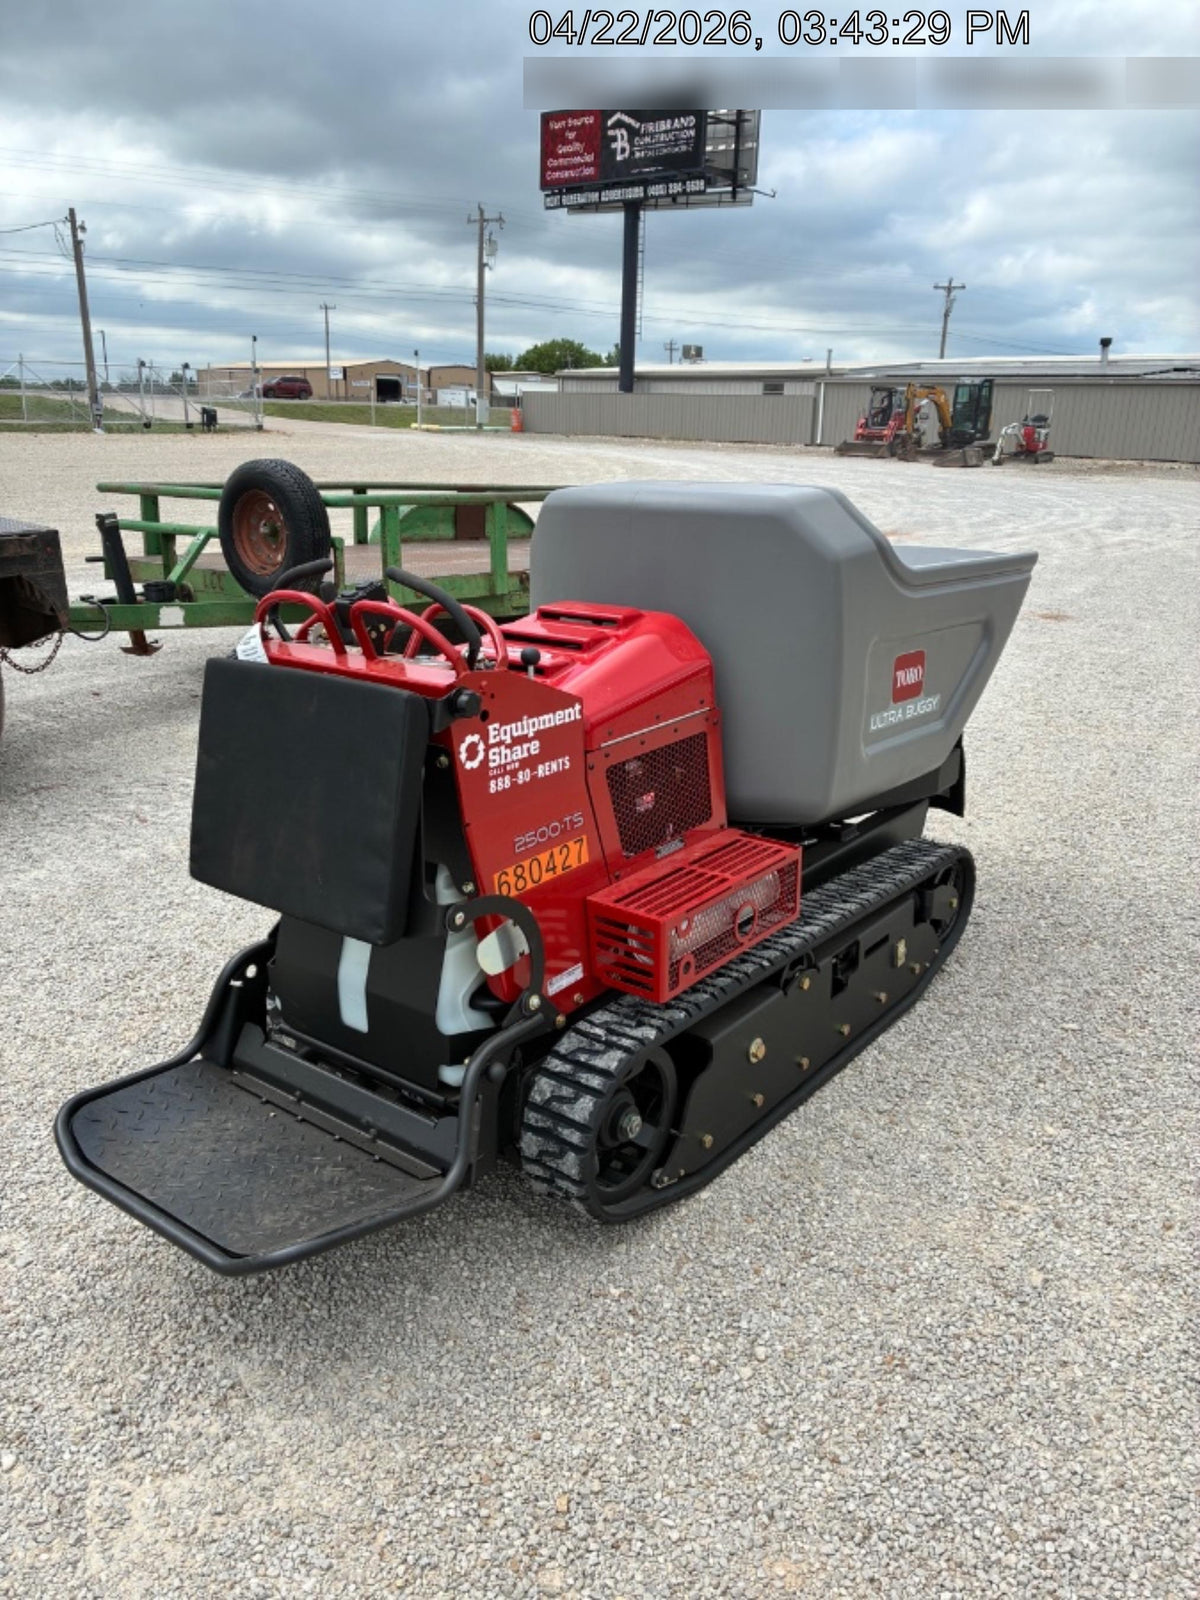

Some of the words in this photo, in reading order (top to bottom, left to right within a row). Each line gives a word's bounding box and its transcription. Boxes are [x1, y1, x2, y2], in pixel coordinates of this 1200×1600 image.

[633, 128, 696, 146] CONSTRUCTION
[640, 115, 696, 134] FIREBRAND
[895, 664, 923, 688] TORO
[488, 702, 582, 744] Equipment
[870, 708, 904, 731] ULTRA
[905, 696, 940, 719] BUGGY
[488, 739, 540, 769] Share
[489, 755, 571, 794] 888-80-RENTS
[496, 838, 585, 897] 680427
